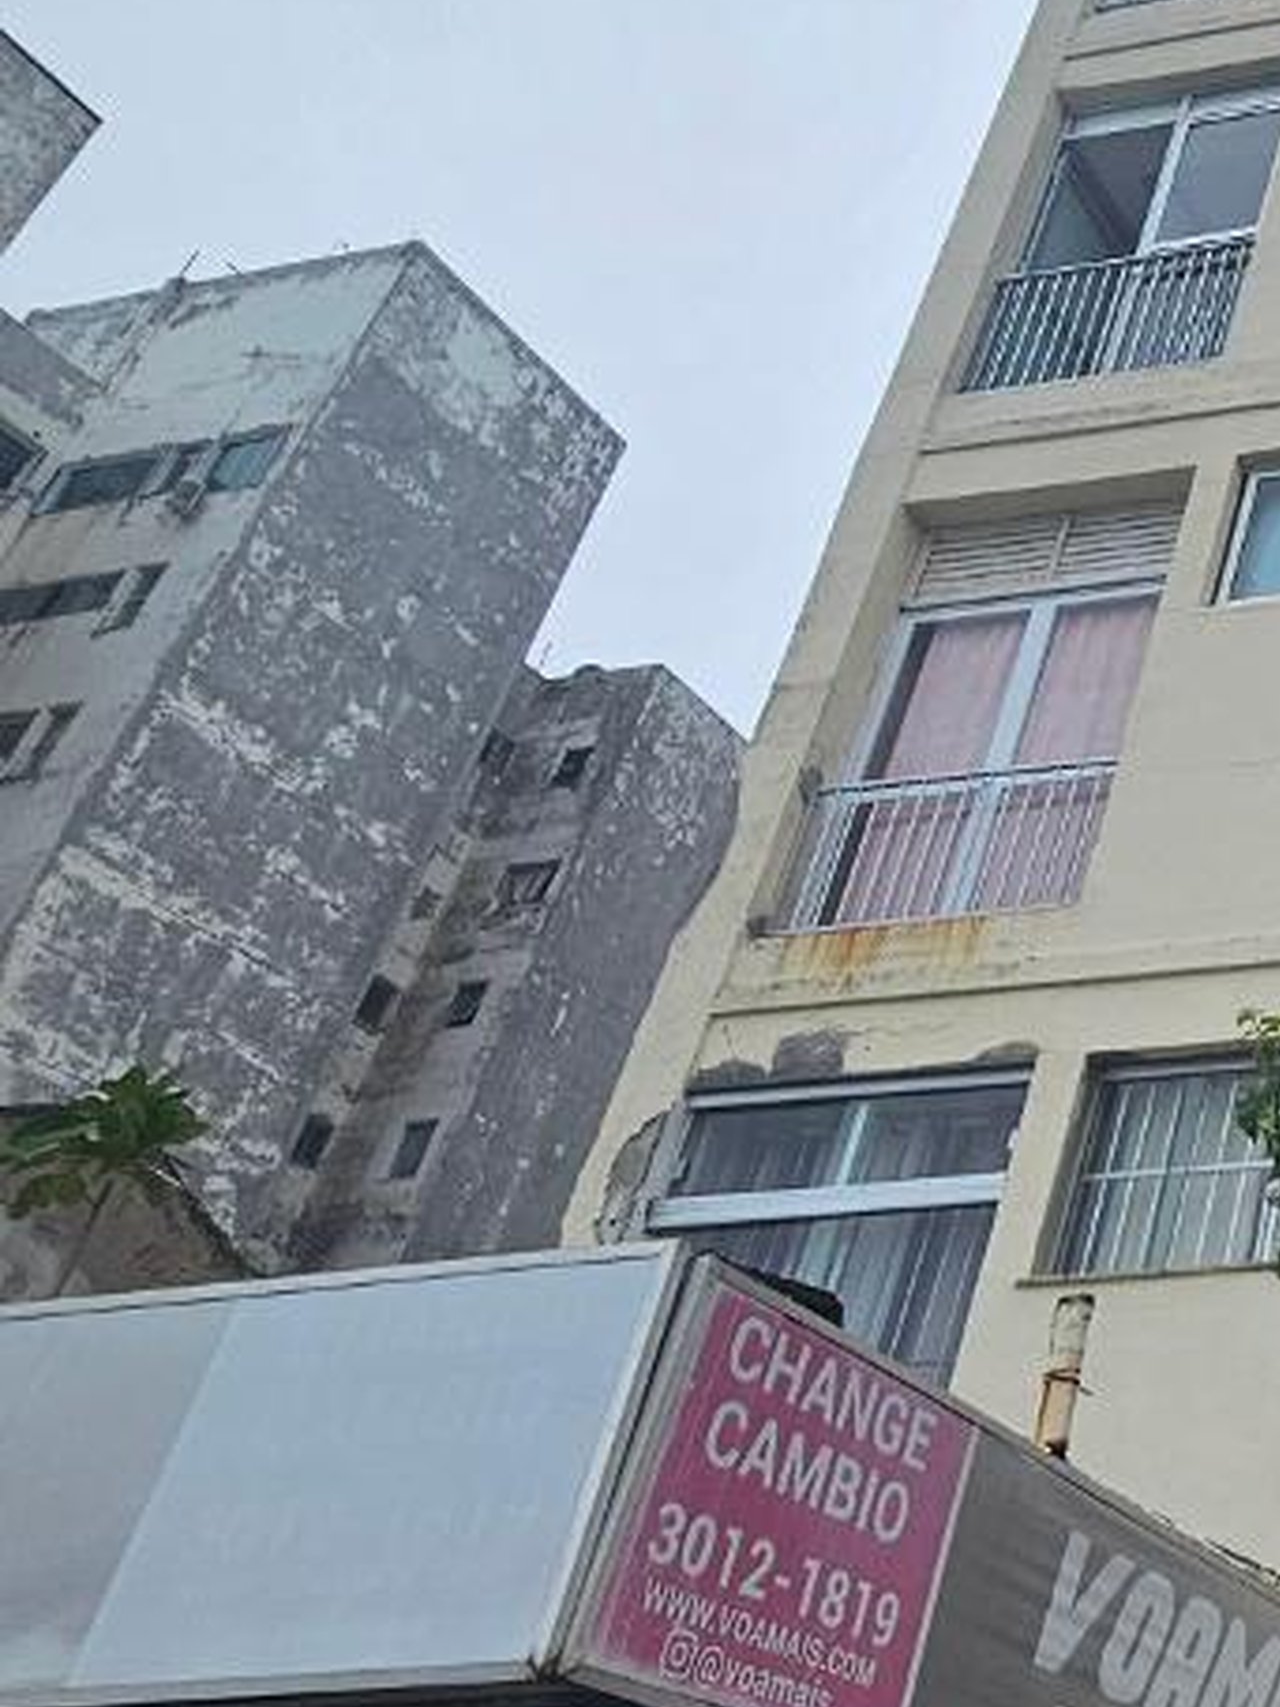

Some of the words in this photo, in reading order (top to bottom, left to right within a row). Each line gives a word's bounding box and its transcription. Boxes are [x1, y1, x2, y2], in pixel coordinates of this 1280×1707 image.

[729, 1316, 937, 1471] CHANGE
[705, 1402, 908, 1544] CAMBIO
[643, 1577, 876, 1688] WWW.VOAMAIS.COM
[648, 1504, 899, 1646] 3012-1819
